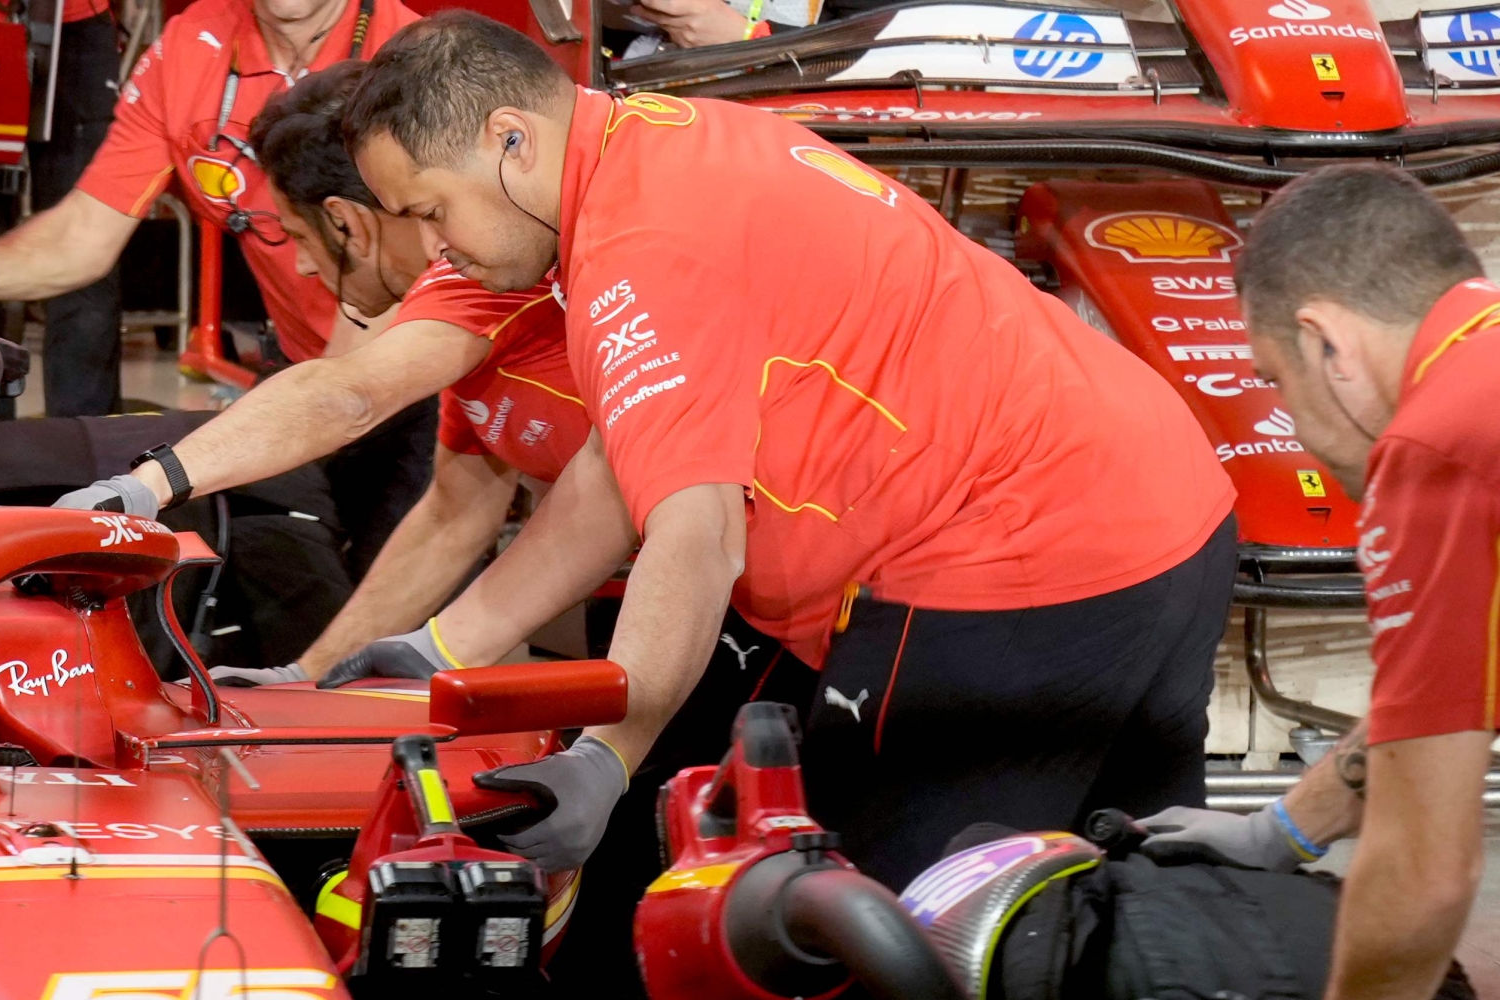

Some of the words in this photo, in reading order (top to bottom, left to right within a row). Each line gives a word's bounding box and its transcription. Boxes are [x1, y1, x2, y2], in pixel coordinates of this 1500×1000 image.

[1021, 10, 1100, 78] hp
[1230, 21, 1384, 46] Santander
[834, 106, 1042, 121] VPower
[589, 279, 632, 318] aws
[1151, 276, 1237, 290] aws
[597, 312, 656, 369] DXC
[1167, 345, 1253, 361] PIRE
[603, 338, 658, 378] TECHNOLOGY
[601, 369, 638, 407] RICHARD
[640, 352, 680, 373] MILLE
[1216, 439, 1304, 462] Santa
[90, 515, 144, 547] DXC
